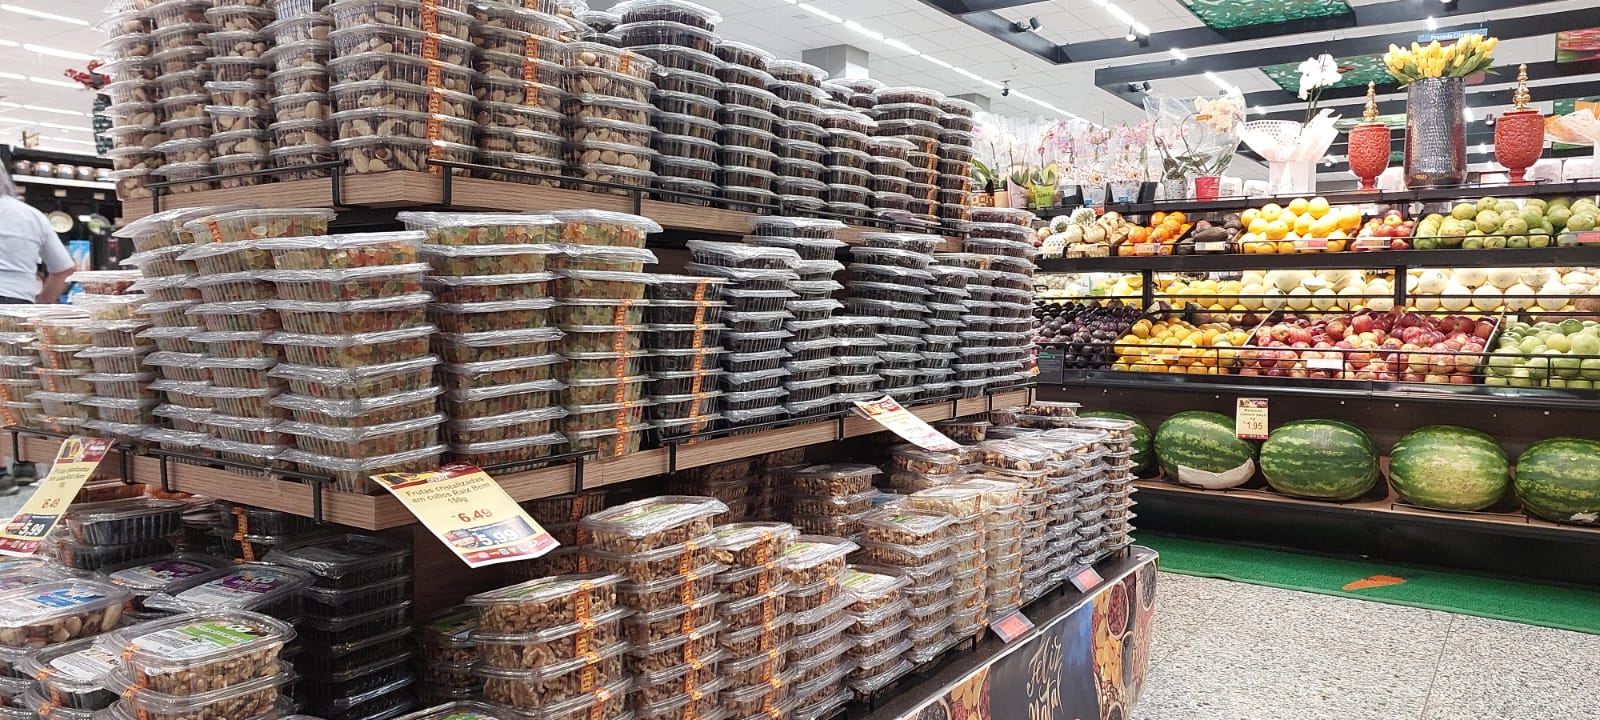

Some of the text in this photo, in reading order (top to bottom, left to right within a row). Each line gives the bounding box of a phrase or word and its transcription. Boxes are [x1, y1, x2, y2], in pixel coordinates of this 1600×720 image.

[405, 486, 434, 497] Frutas
[435, 477, 484, 491] cristalizadas
[412, 483, 490, 503] em cubos Raiz Bem
[458, 508, 493, 523] 6,49
[19, 523, 45, 537] 5,99
[478, 530, 518, 546] 5,99
[1026, 635, 1063, 697] Feliz
